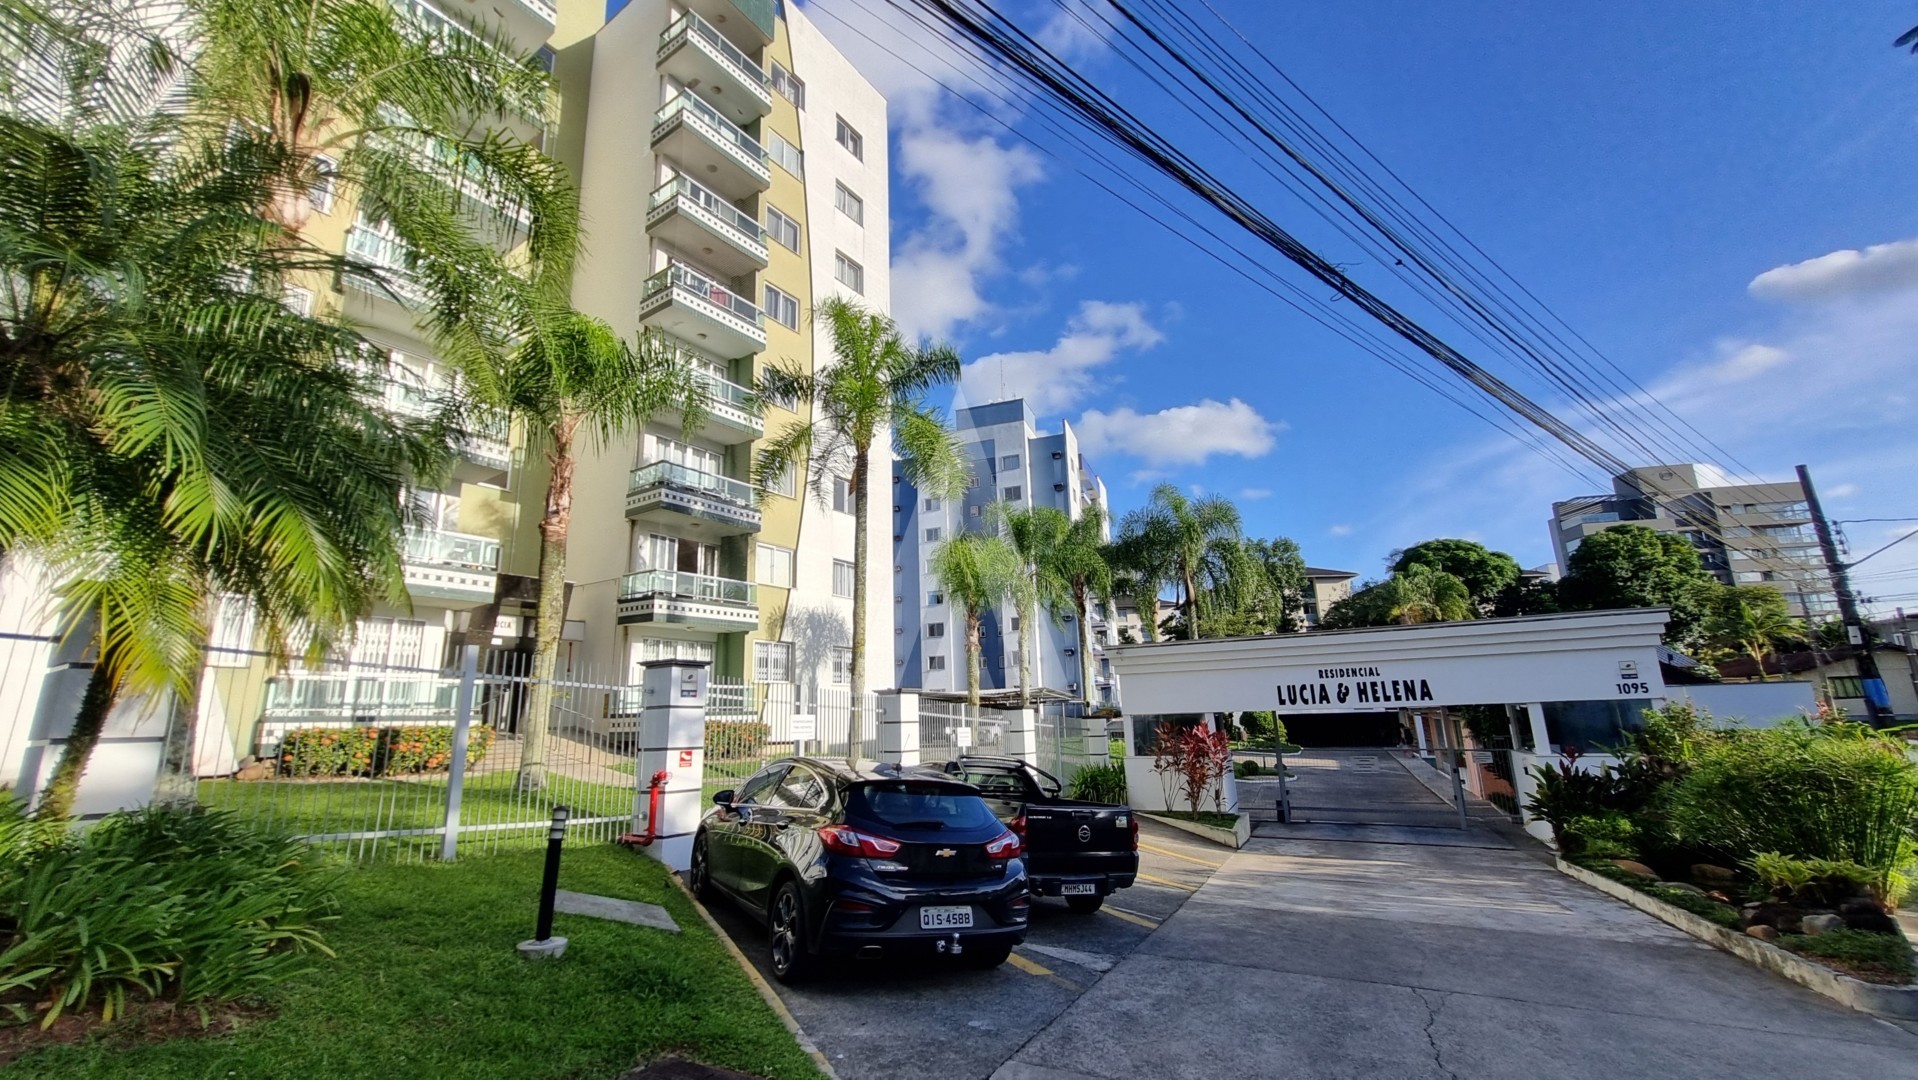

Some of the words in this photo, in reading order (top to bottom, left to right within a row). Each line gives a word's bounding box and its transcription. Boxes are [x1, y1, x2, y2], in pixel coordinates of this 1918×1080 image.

[495, 620, 512, 629] UCIA
[1318, 667, 1381, 679] RESIDENCIAL
[1276, 683, 1331, 706] LUCIA
[1336, 682, 1350, 704] &
[1356, 679, 1434, 703] HELENA
[1615, 682, 1649, 694] 1095
